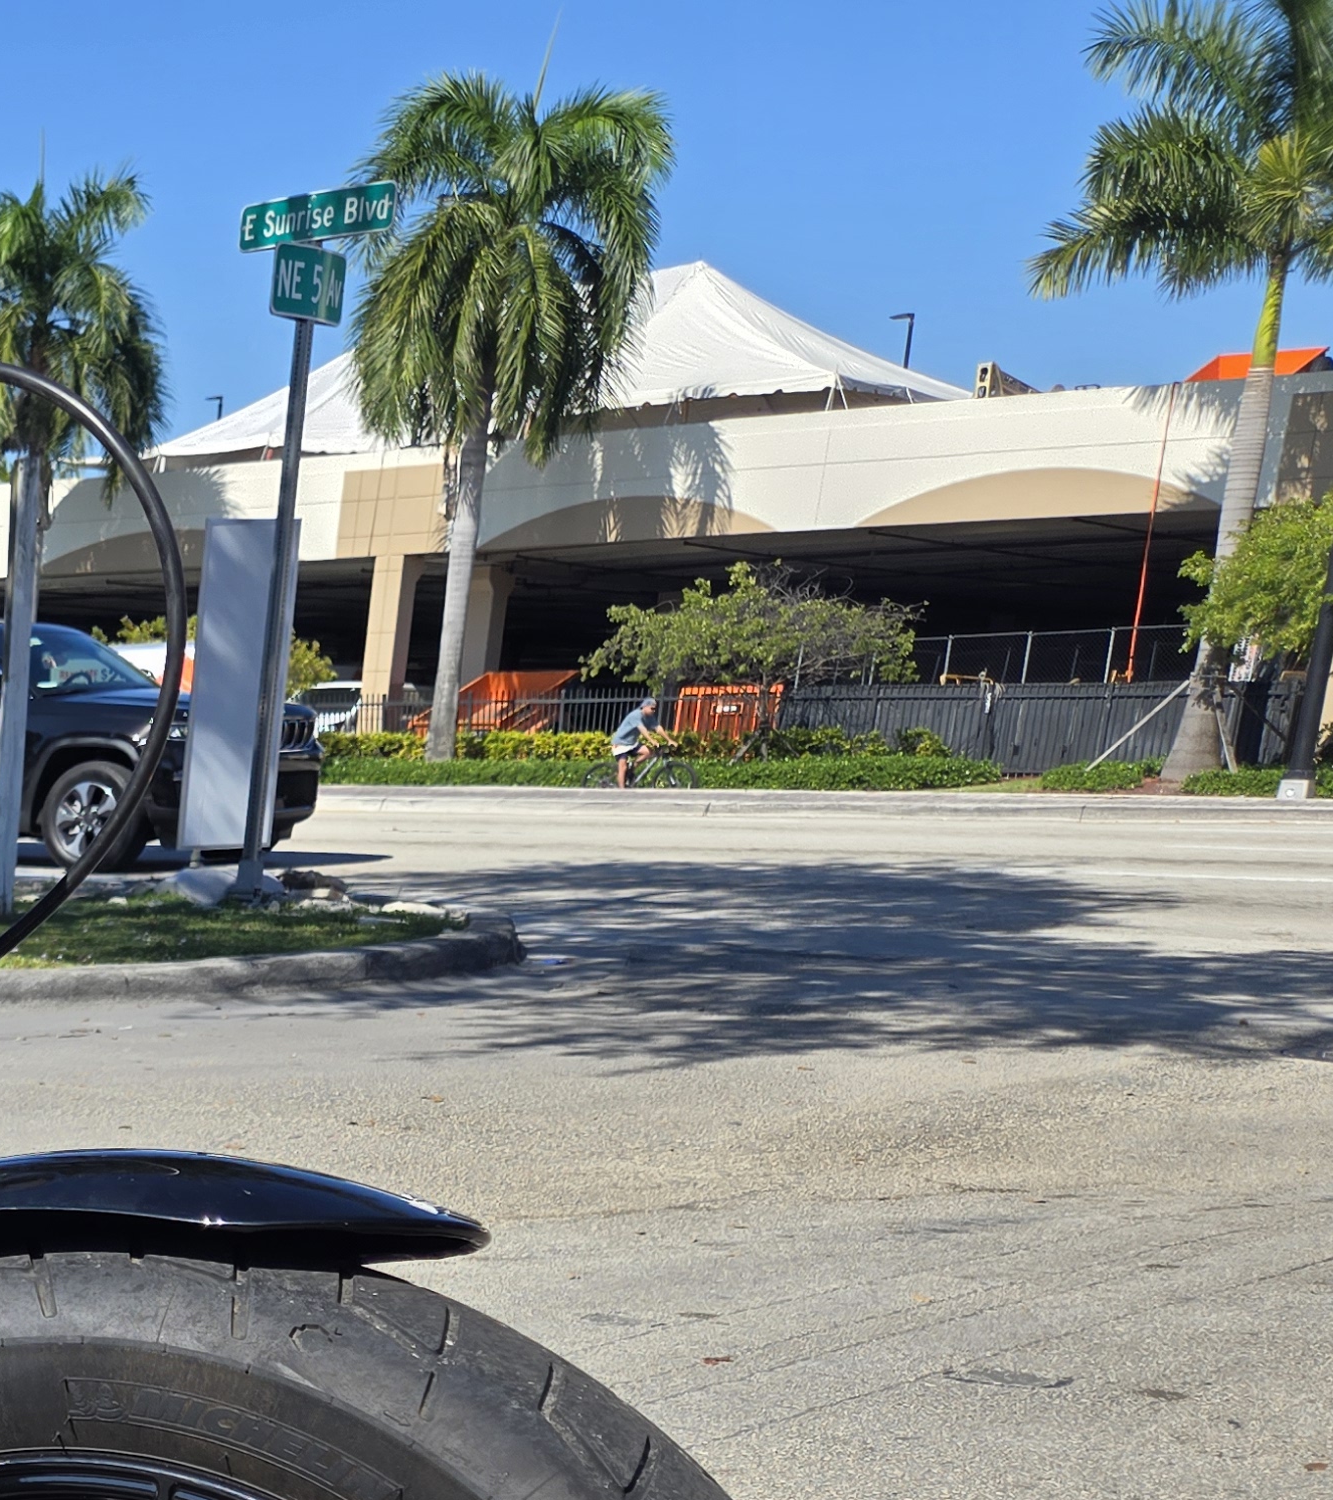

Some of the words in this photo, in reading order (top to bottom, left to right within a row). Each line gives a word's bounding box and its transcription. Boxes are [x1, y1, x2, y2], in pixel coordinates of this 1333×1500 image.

[244, 214, 257, 241] E
[263, 203, 333, 238] Sunrise
[343, 193, 391, 224] Blvd
[277, 258, 305, 300] NE
[311, 264, 323, 304] 5
